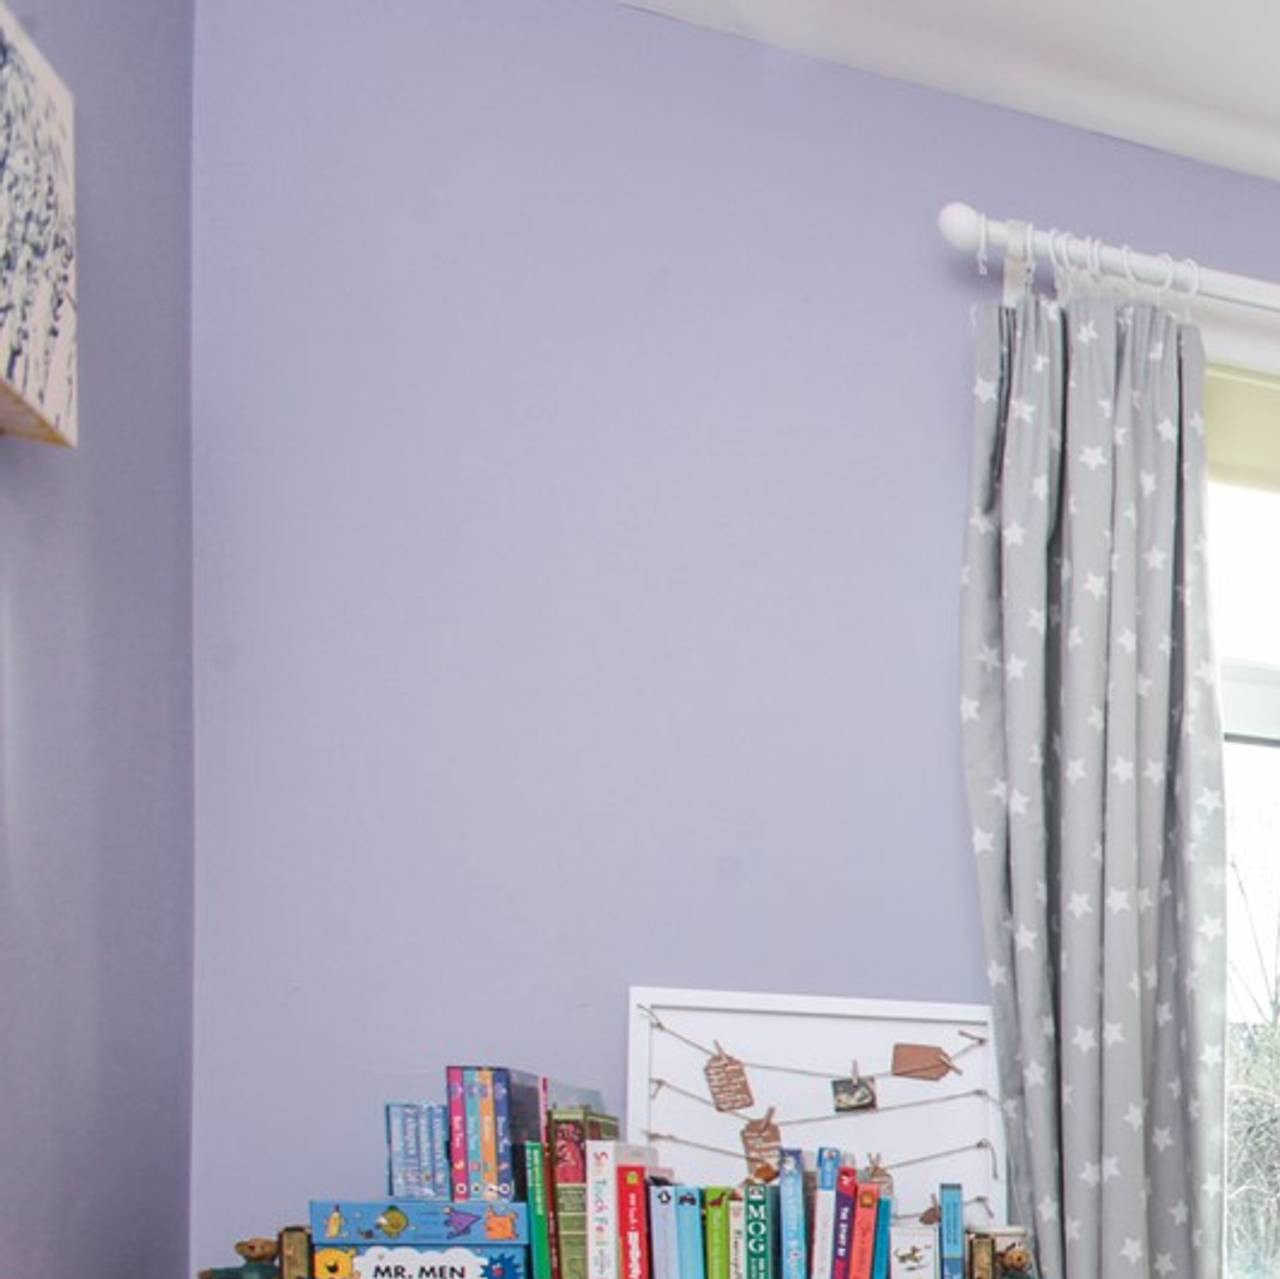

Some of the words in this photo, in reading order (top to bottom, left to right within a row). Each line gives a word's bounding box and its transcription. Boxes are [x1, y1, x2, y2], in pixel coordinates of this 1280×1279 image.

[748, 1205, 766, 1252] MOG
[374, 1265, 413, 1279] MR.
[418, 1265, 465, 1279] MEN
